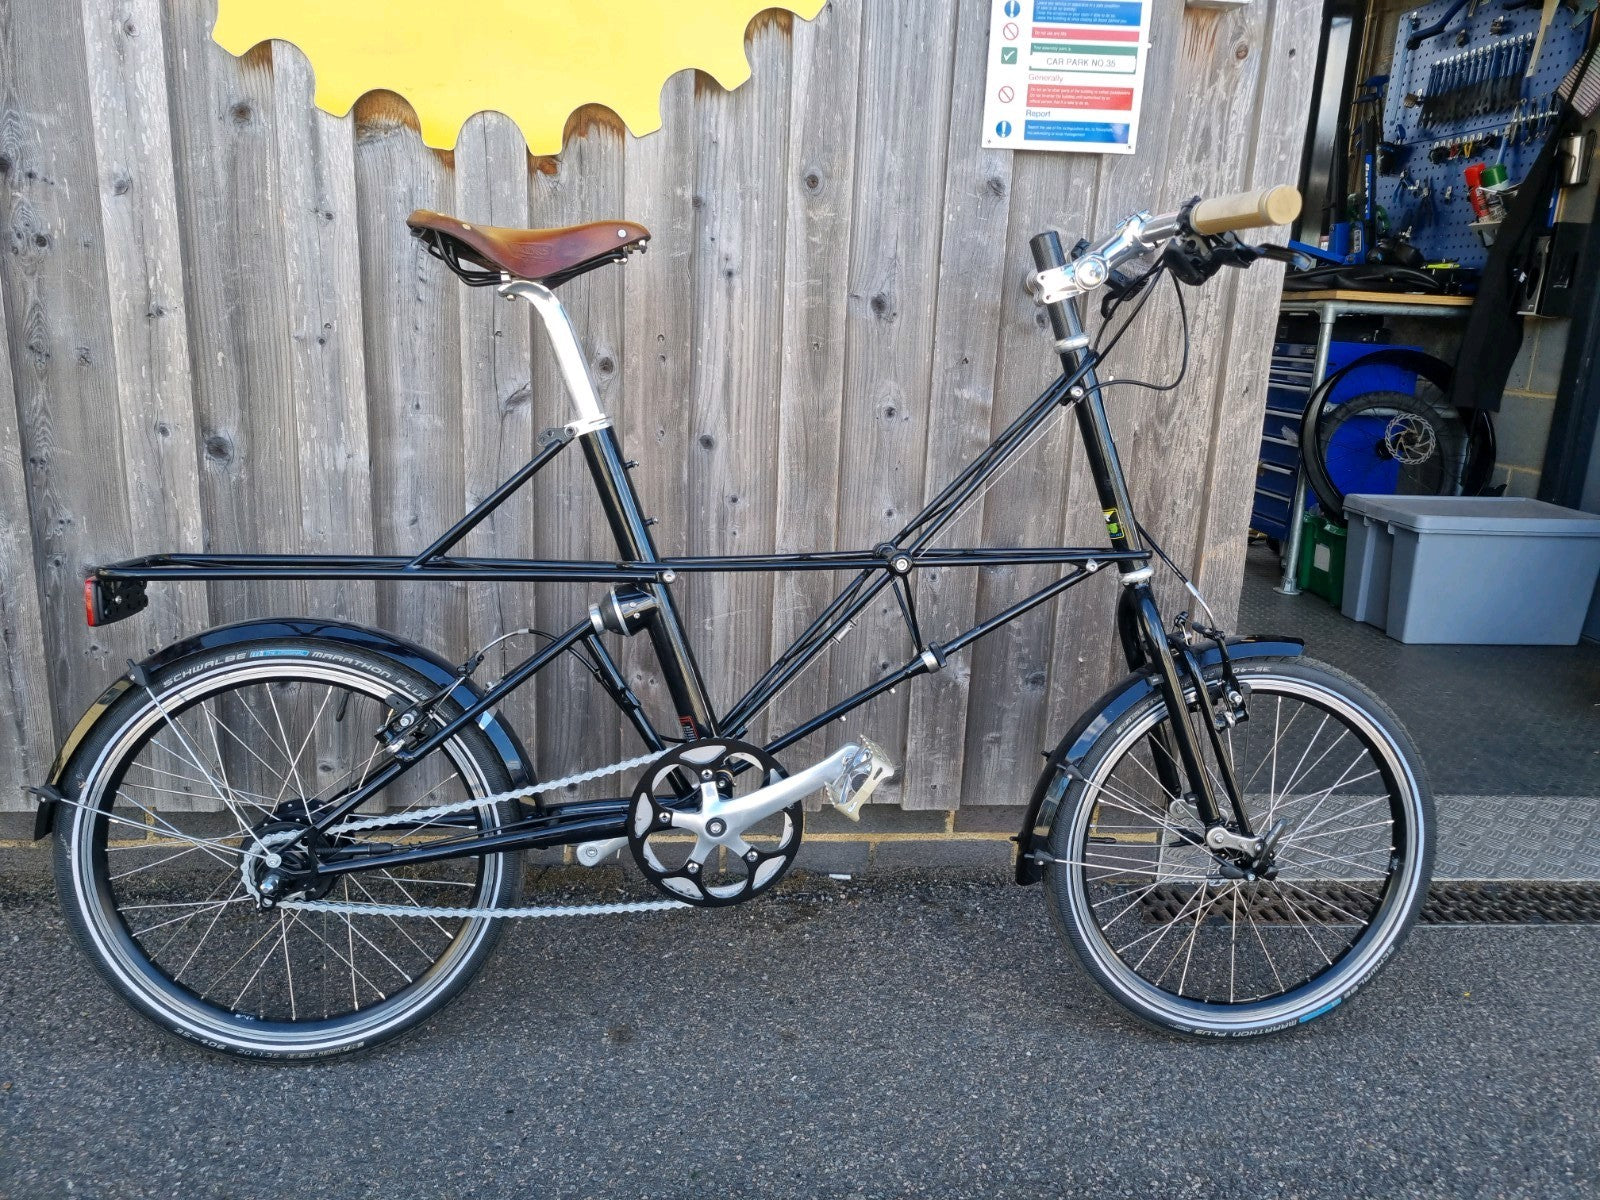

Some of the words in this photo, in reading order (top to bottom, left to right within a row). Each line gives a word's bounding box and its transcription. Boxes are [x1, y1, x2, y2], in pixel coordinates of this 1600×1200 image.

[1046, 57, 1064, 66] CAR
[1066, 58, 1089, 67] PARK
[1028, 73, 1063, 83] Generally
[1025, 109, 1051, 118] Report
[163, 652, 247, 688] SCHWALBE
[311, 651, 392, 678] MARATHON
[395, 679, 429, 701] PLUS
[1343, 944, 1395, 998] SCHWALBE
[1194, 1029, 1227, 1037] PLUS
[1232, 1019, 1297, 1037] MARATHON
